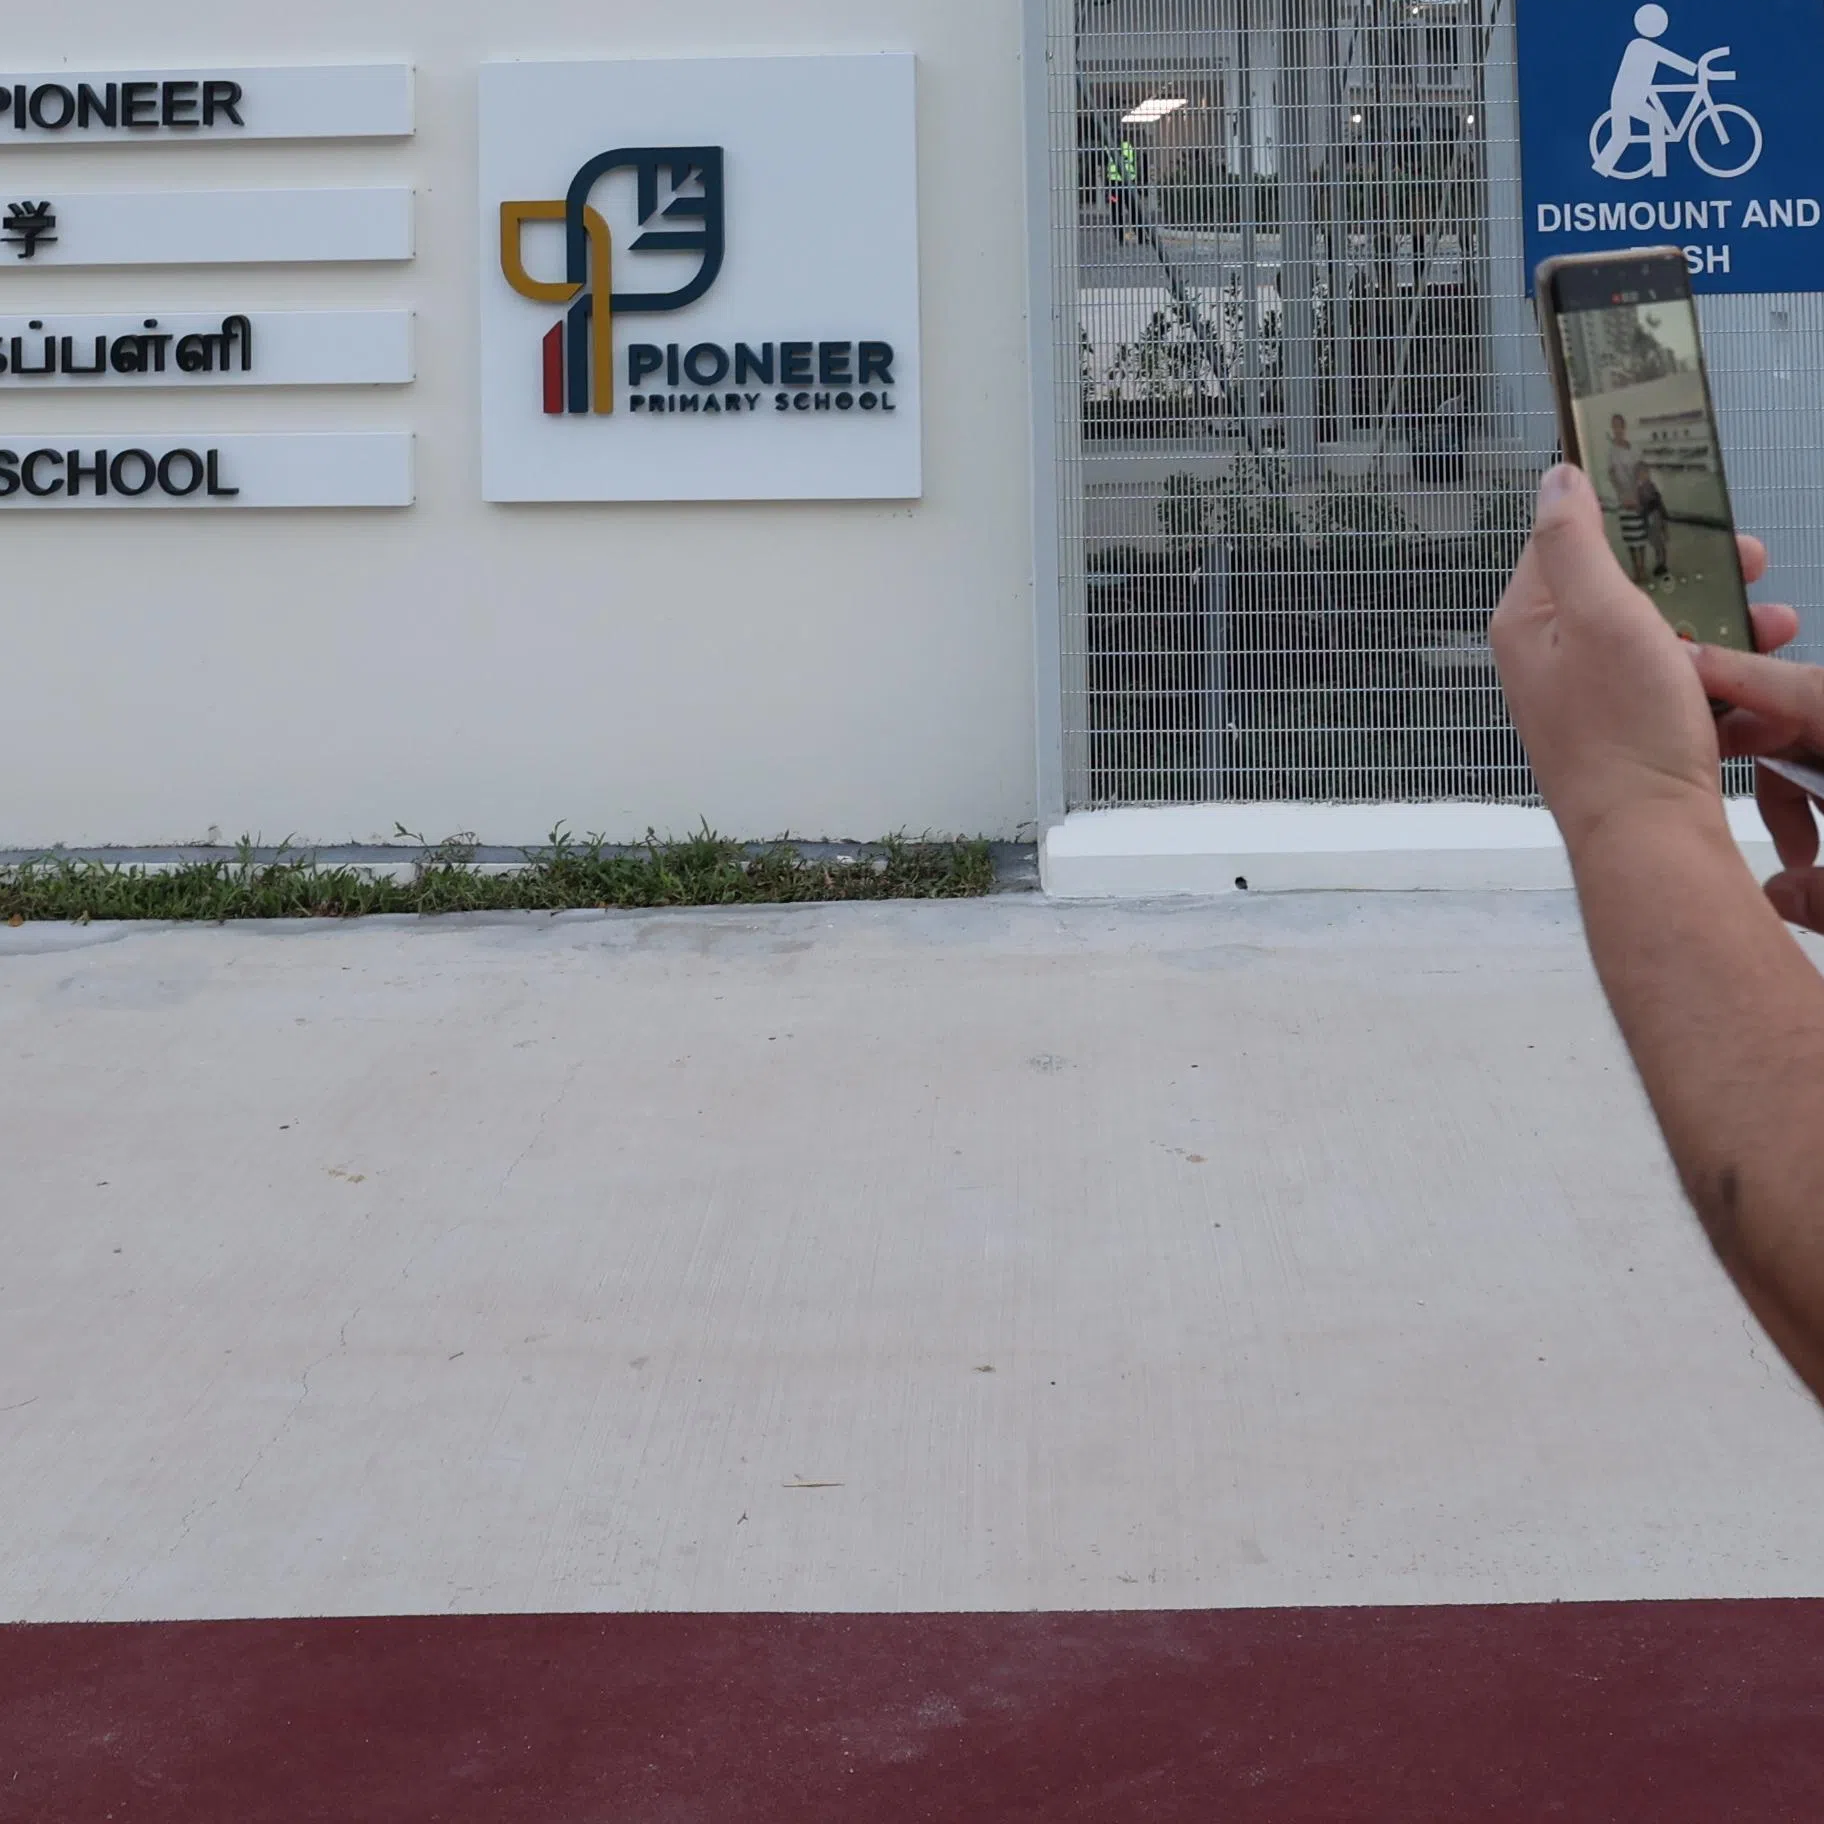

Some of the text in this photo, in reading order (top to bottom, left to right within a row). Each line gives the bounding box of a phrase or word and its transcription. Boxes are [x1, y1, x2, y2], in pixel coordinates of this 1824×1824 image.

[1537, 198, 1821, 232] DISMOUNT AND
[1682, 244, 1731, 275] SH
[628, 341, 896, 386] PIONEER
[629, 390, 896, 413] PRIMARY SCHOOL
